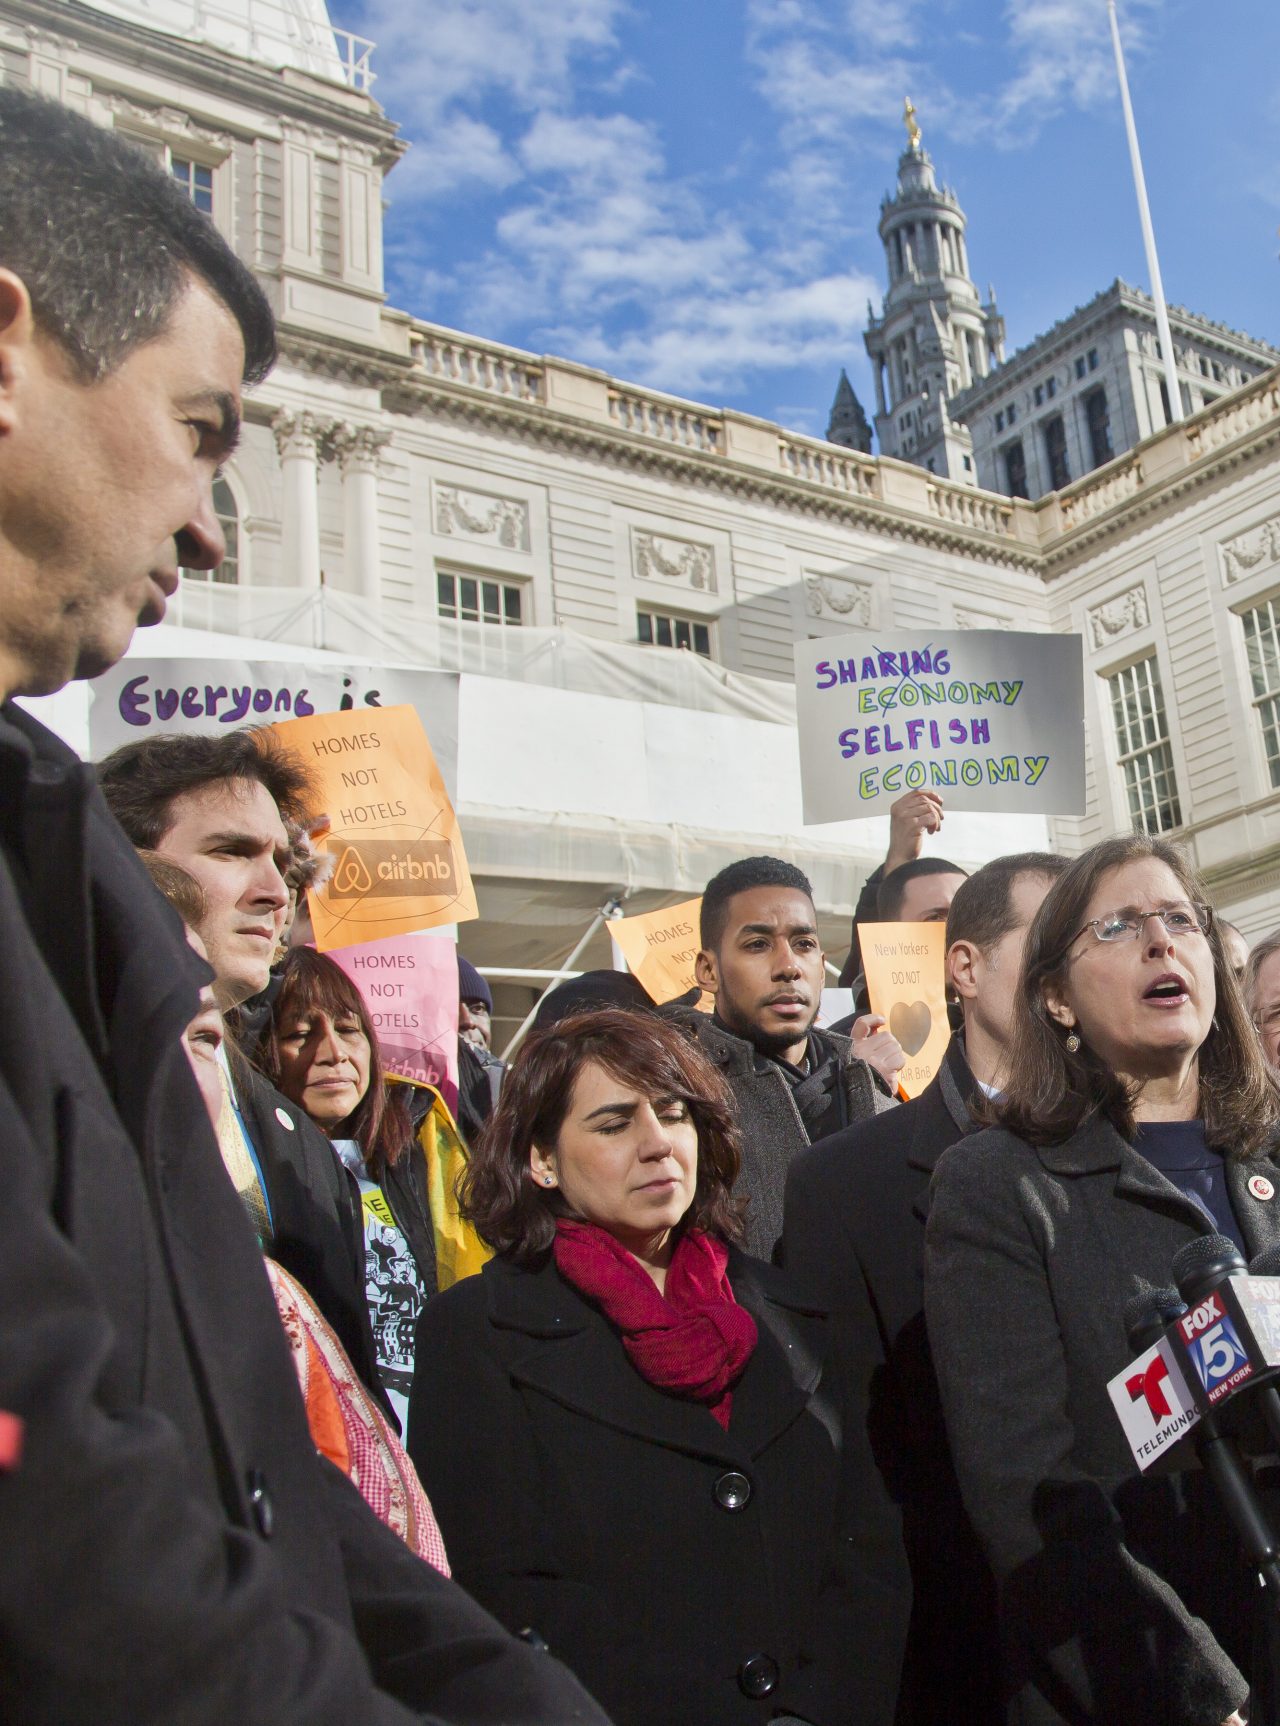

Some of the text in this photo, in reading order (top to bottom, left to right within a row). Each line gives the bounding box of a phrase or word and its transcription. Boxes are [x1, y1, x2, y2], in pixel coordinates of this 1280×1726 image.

[815, 649, 951, 690] SHARING
[118, 675, 315, 726] Everyone
[857, 680, 1024, 714] ECONOMY
[312, 732, 381, 756] HOMES
[838, 717, 992, 760] SELFISH
[341, 768, 379, 788] NOT
[858, 755, 1050, 800] ECONOMY
[340, 799, 407, 826] HOTELS
[377, 853, 451, 881] airbnb
[645, 921, 694, 946] HOMES
[353, 955, 416, 969] HOMES
[874, 941, 929, 957] New Yorkers
[370, 983, 405, 997] NOT
[891, 970, 921, 985] DO NOT
[371, 1013, 419, 1028] OTELS
[1181, 1295, 1222, 1340] FOX
[1200, 1322, 1235, 1379] 5
[1208, 1366, 1252, 1403] NEW YORK
